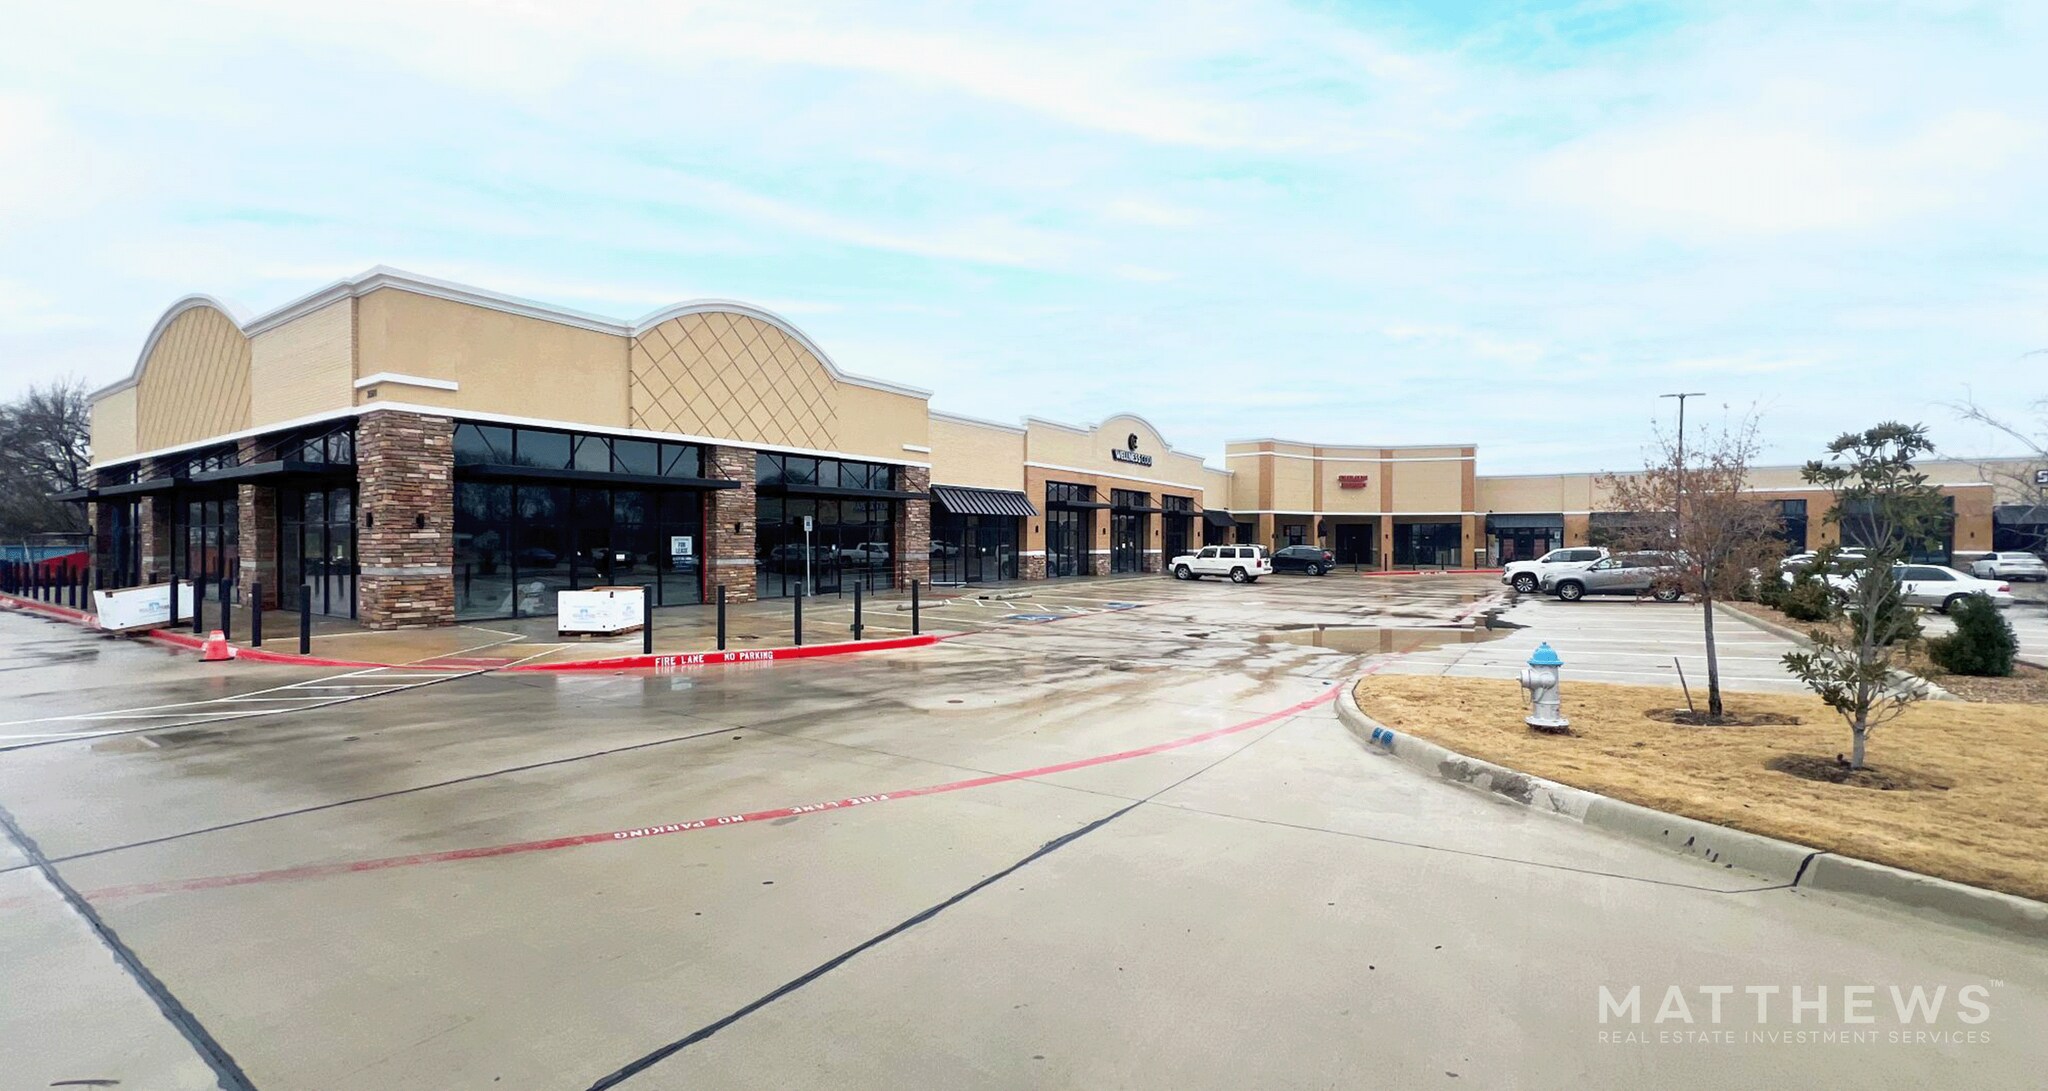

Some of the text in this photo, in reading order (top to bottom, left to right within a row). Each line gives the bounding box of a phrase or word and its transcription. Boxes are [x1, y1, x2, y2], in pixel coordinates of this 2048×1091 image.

[1115, 449, 1140, 464] WELLNESS
[655, 653, 705, 667] FIRE LANE
[724, 651, 773, 662] NO PARKING
[790, 793, 889, 814] FIRE LANE
[613, 815, 745, 839] NO PARKING
